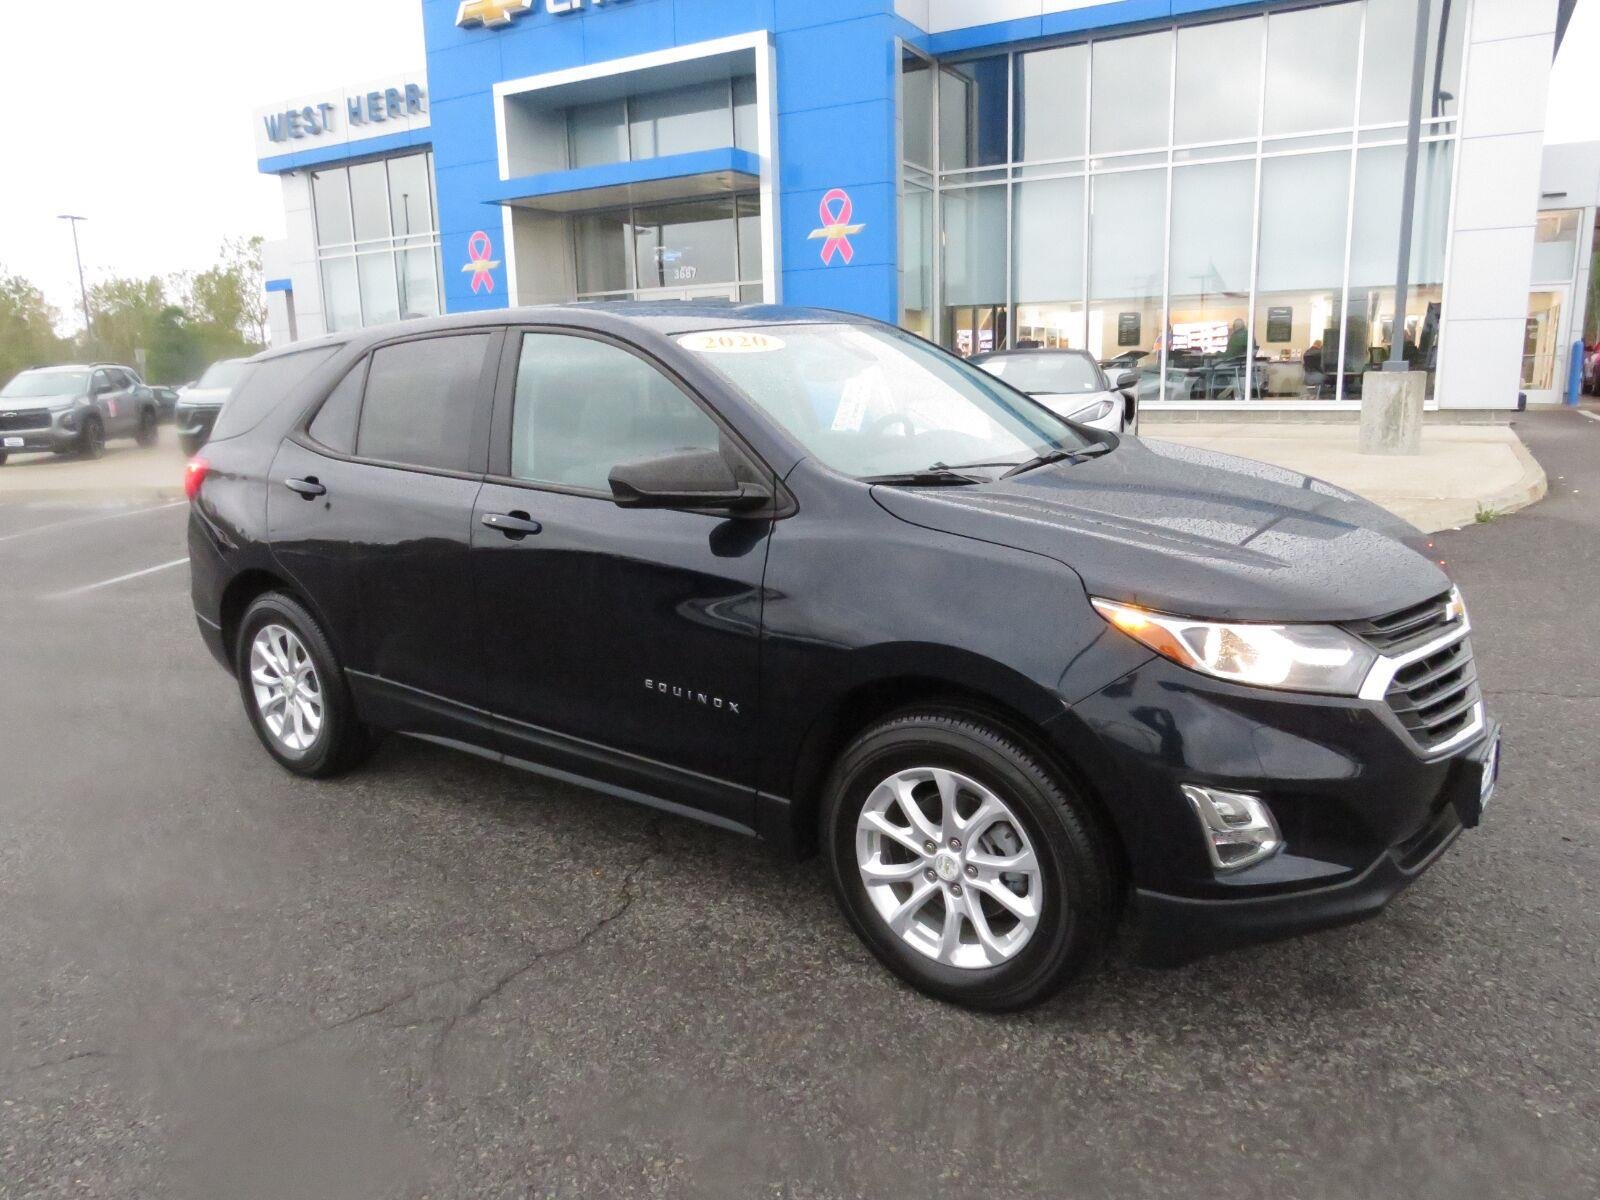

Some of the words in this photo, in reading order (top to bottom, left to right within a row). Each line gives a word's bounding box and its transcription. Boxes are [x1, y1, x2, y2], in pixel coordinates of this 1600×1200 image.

[264, 102, 335, 142] WEST
[347, 83, 425, 126] HERR
[673, 265, 697, 280] 3687
[705, 335, 769, 349] 2020
[644, 678, 740, 714] EQUINOX
